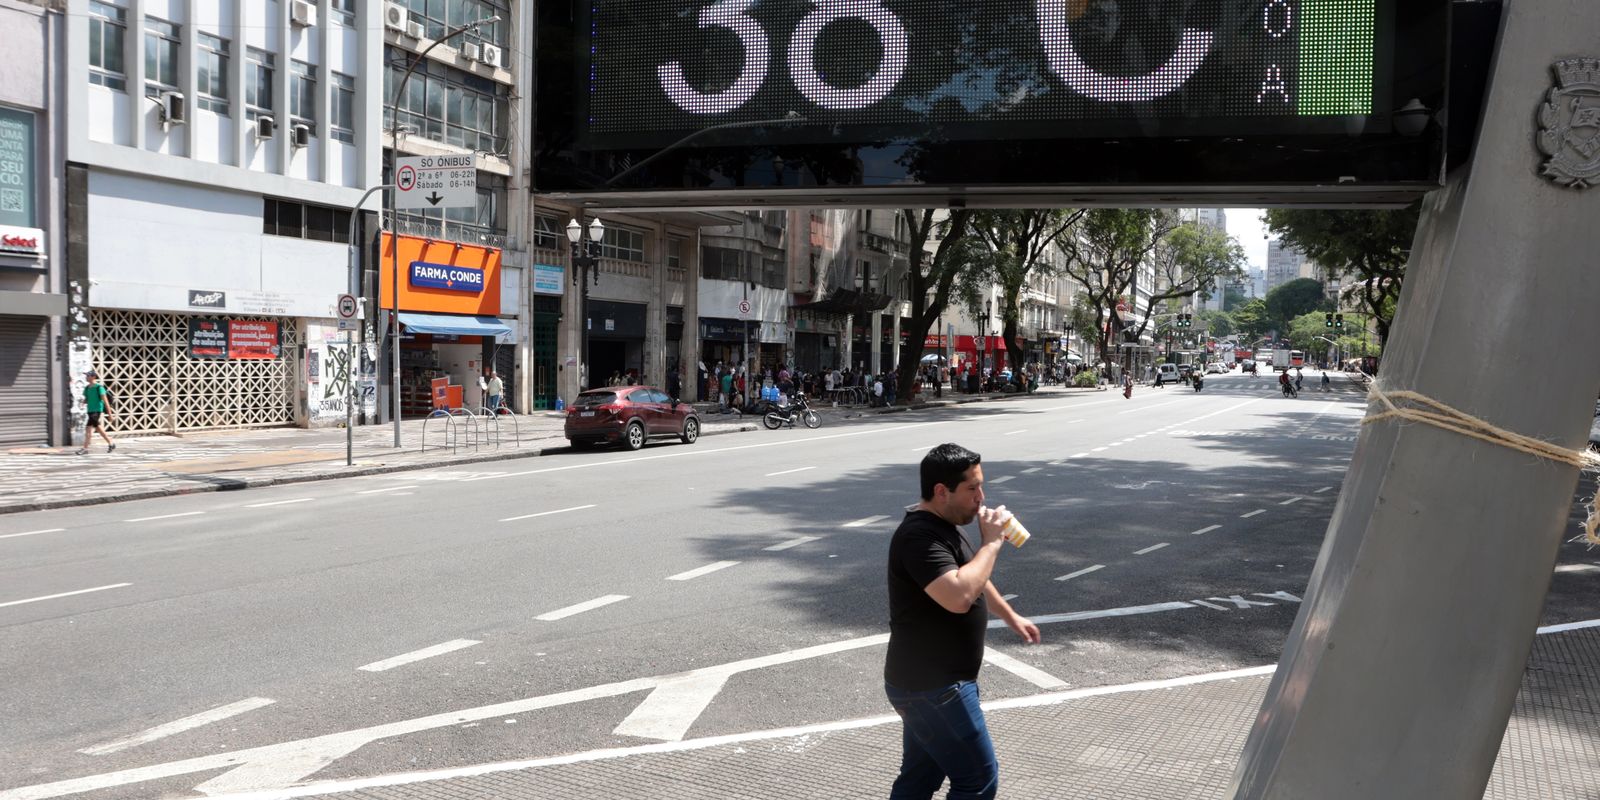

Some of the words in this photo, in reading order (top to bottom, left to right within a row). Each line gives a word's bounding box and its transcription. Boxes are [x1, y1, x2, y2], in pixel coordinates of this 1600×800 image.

[1, 127, 24, 140] UMA
[1, 160, 24, 174] SEU
[421, 156, 433, 167] SÓ
[437, 155, 471, 167] ÔNIBUS
[0, 172, 24, 186] CIO.
[416, 180, 443, 189] Sábado
[415, 266, 448, 280] FARMA
[449, 270, 482, 284] CONDE
